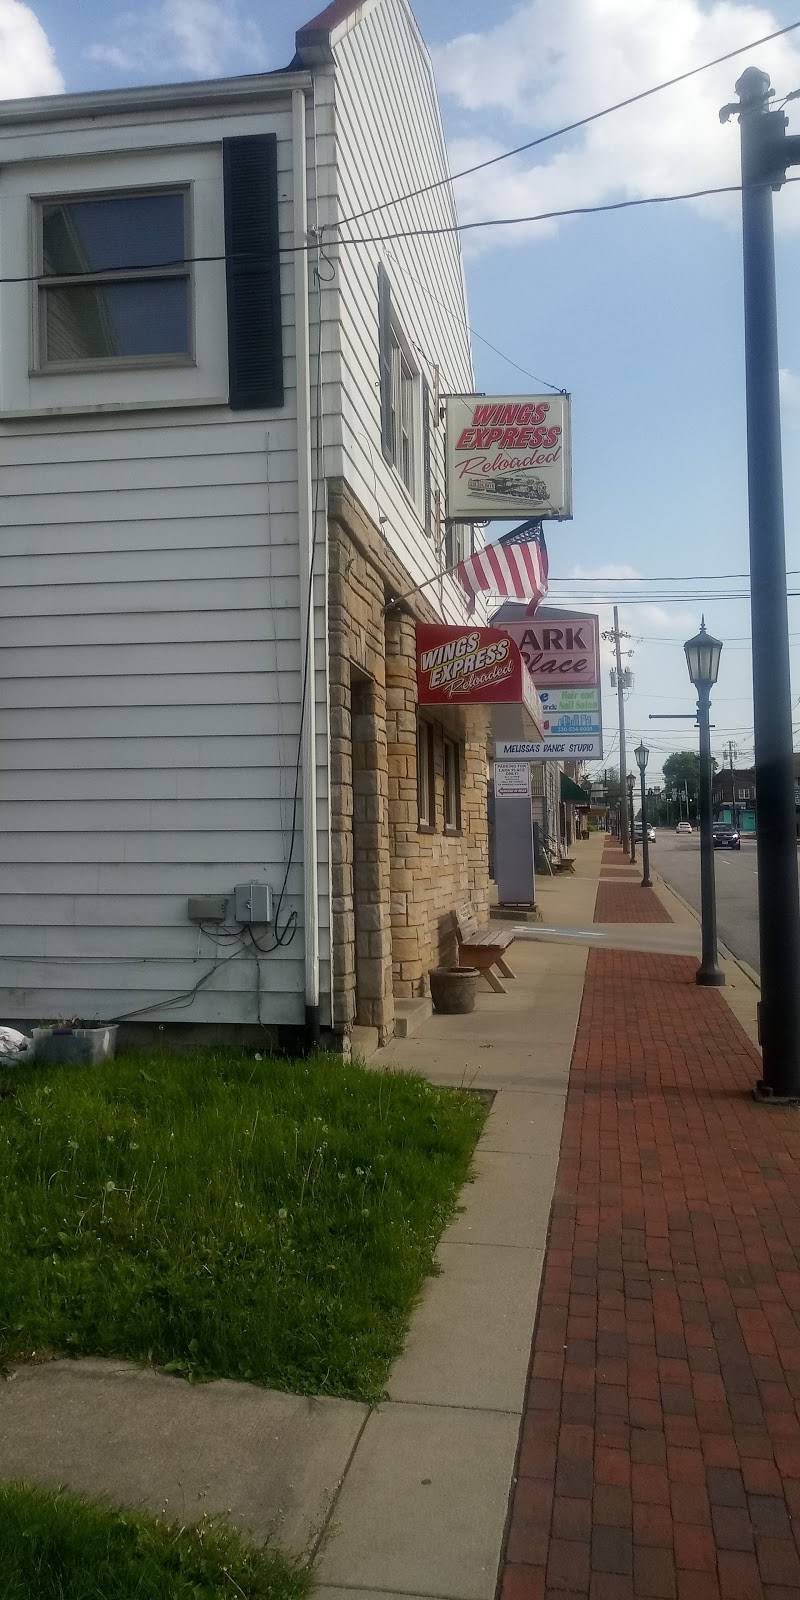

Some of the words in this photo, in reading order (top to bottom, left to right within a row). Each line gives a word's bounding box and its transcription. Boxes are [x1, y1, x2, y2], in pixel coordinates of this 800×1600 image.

[472, 402, 550, 427] WINGS
[455, 425, 562, 450] EXPRESS
[454, 446, 562, 479] Reloaded
[421, 631, 480, 672] WINGS
[520, 627, 587, 651] ARK
[429, 638, 511, 690] EXPRESS
[443, 659, 513, 699] Reloaded
[503, 744, 541, 754] MELISSA'S
[543, 744, 565, 753] DANCE
[568, 743, 594, 753] STUDIO
